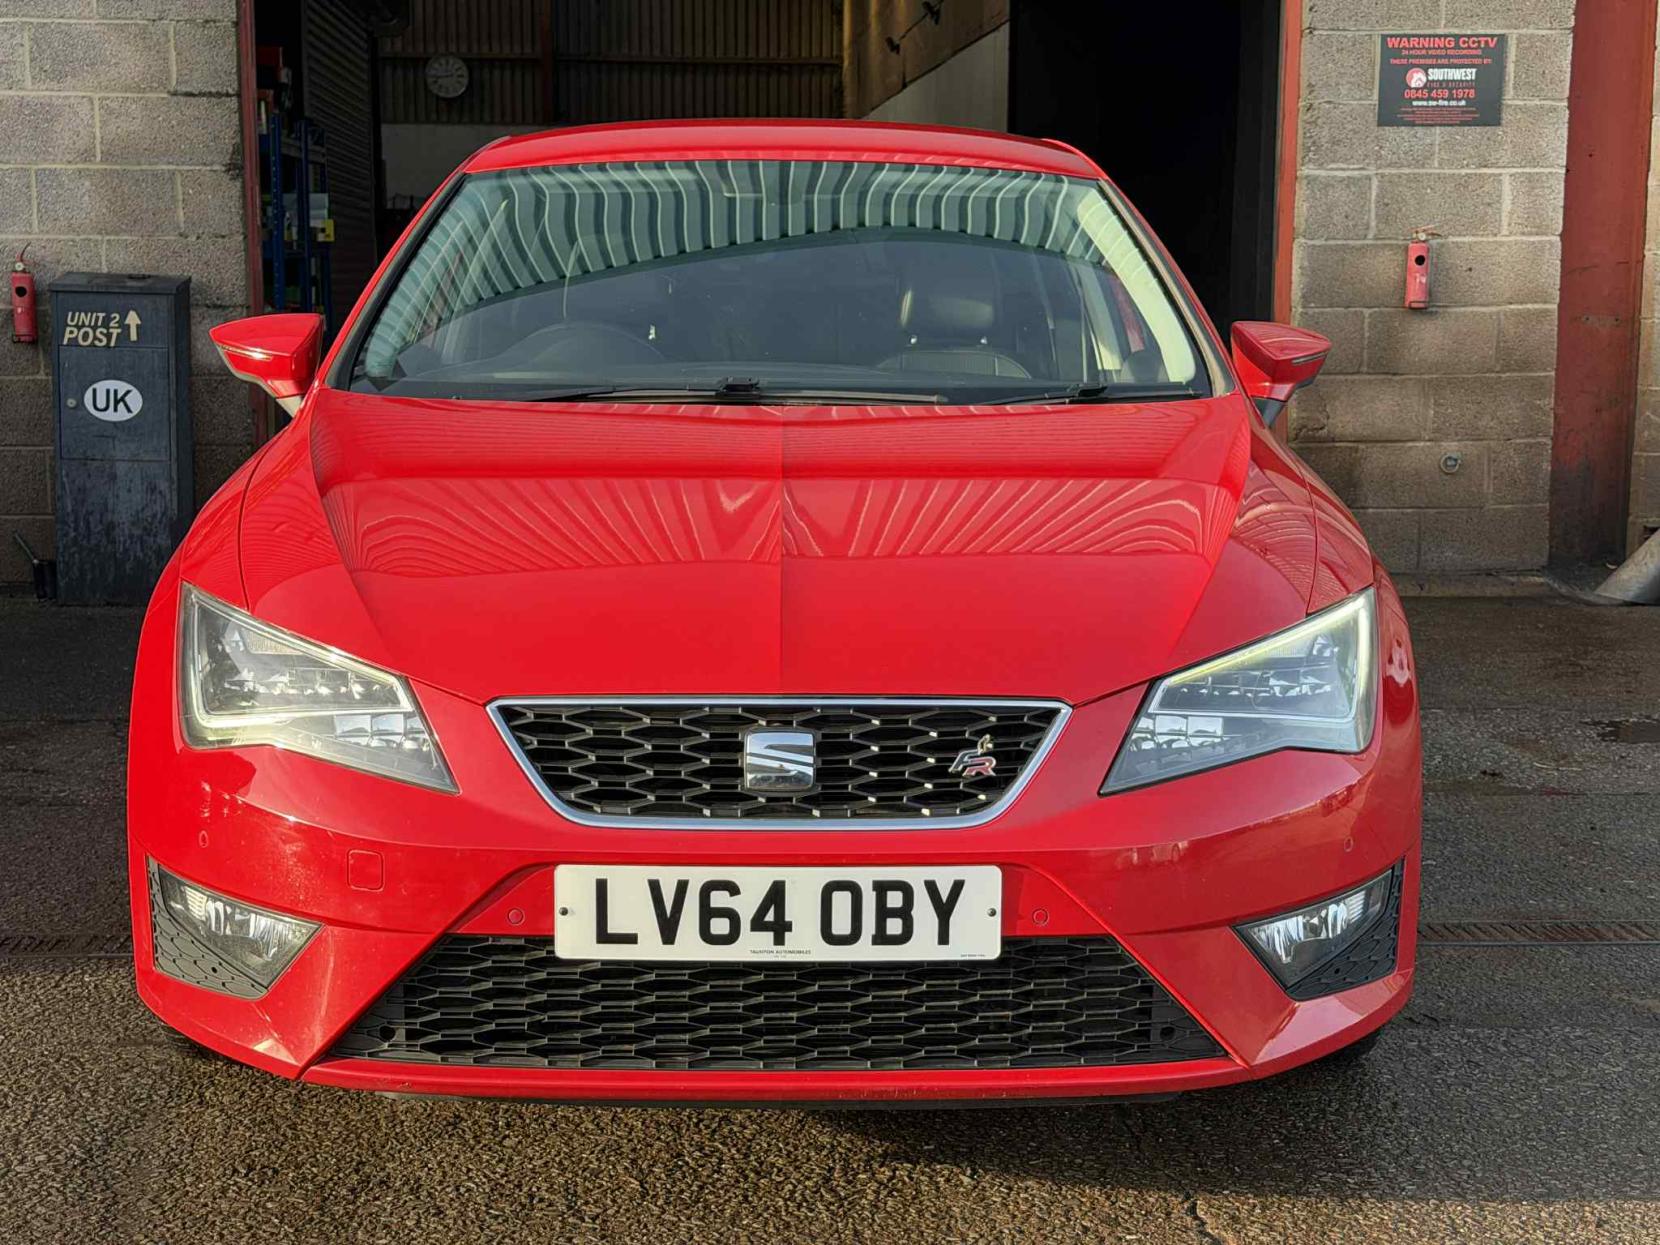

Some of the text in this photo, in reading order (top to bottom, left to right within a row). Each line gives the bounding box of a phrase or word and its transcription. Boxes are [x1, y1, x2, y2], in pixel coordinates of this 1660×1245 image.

[1387, 37, 1498, 48] WARNING CCTV
[1427, 68, 1477, 80] SOUTHWEST
[1404, 89, 1475, 98] 0845 459 1978
[67, 311, 121, 327] UNIT 2
[63, 327, 122, 347] POST
[92, 388, 133, 414] UK
[595, 878, 966, 946] LV64 OBY
